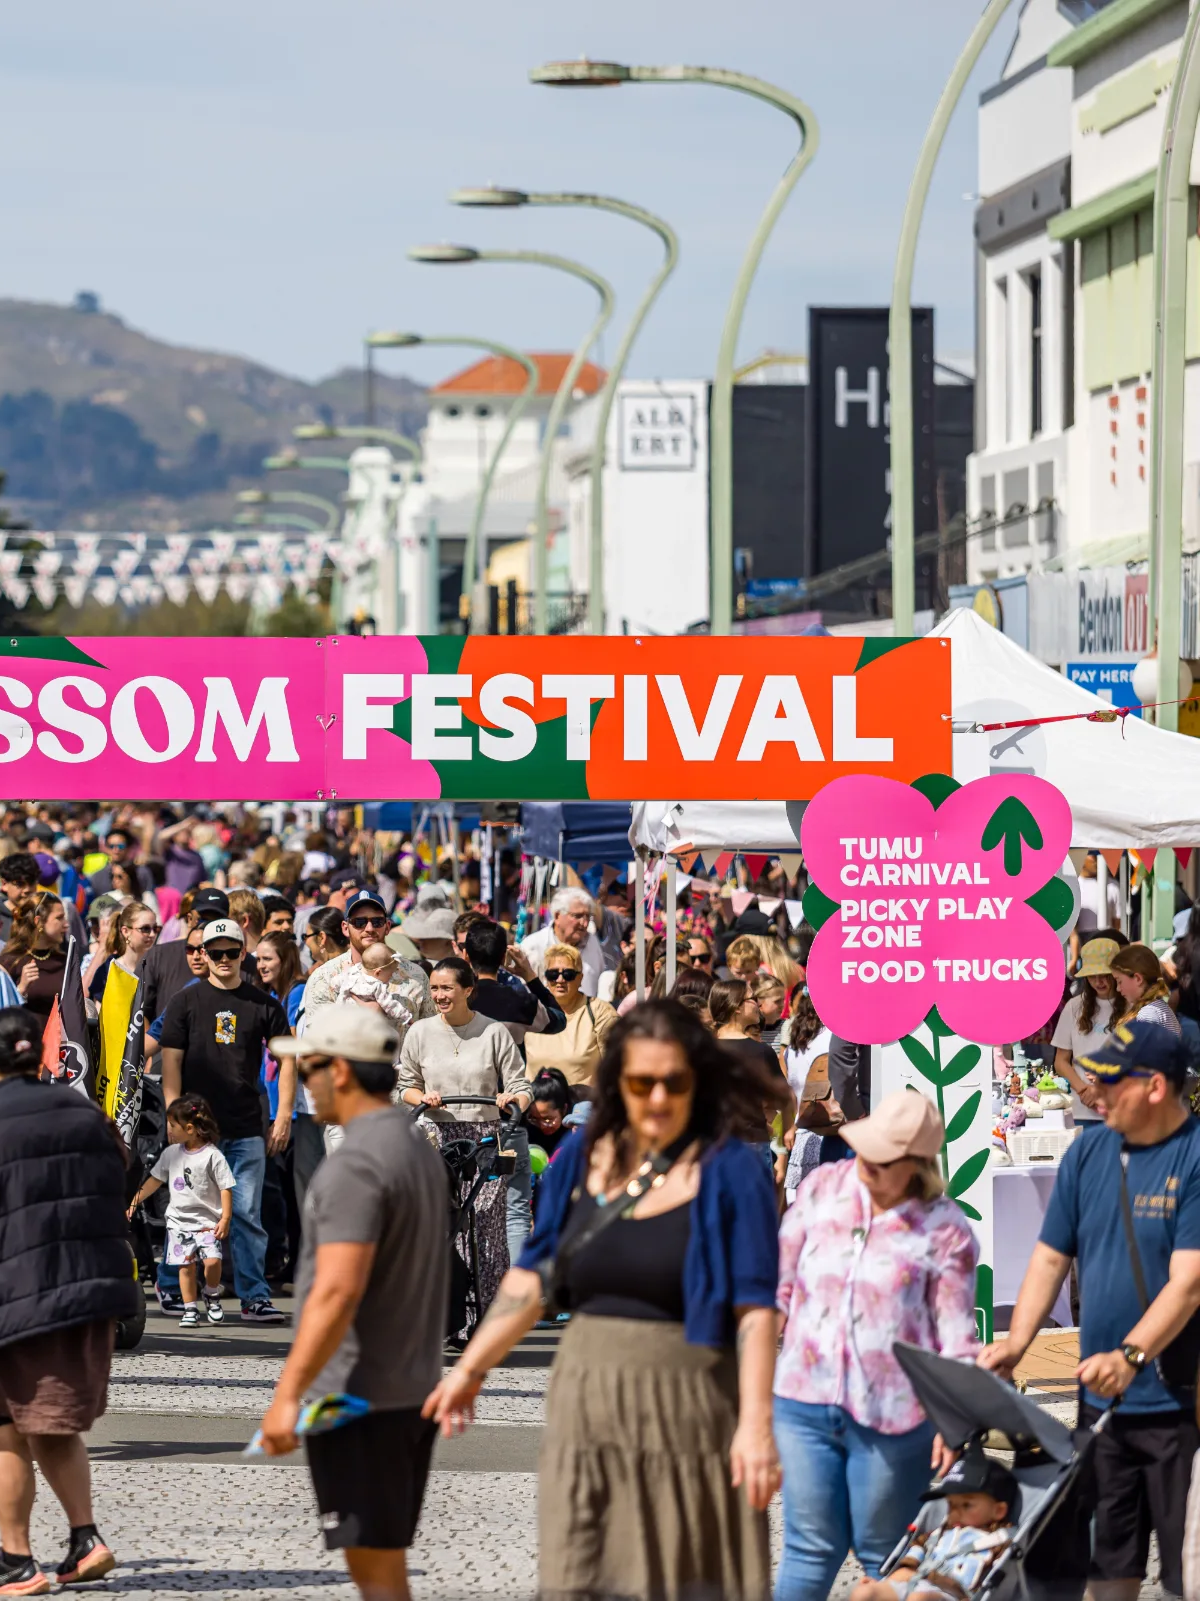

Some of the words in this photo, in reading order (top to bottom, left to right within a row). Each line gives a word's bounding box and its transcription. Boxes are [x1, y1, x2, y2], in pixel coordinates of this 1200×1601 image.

[835, 366, 880, 429] H
[1079, 578, 1122, 654] Bendon
[1071, 669, 1097, 683] PAY
[342, 673, 894, 762] FESTIVAL
[839, 837, 923, 860] TUMU
[840, 862, 990, 887] CARNIVAL
[840, 898, 931, 922] PICKY
[938, 897, 1013, 921] PLAY
[841, 924, 922, 948] ZONE
[841, 960, 926, 984] FOOD
[936, 957, 1048, 982] TRUCKS
